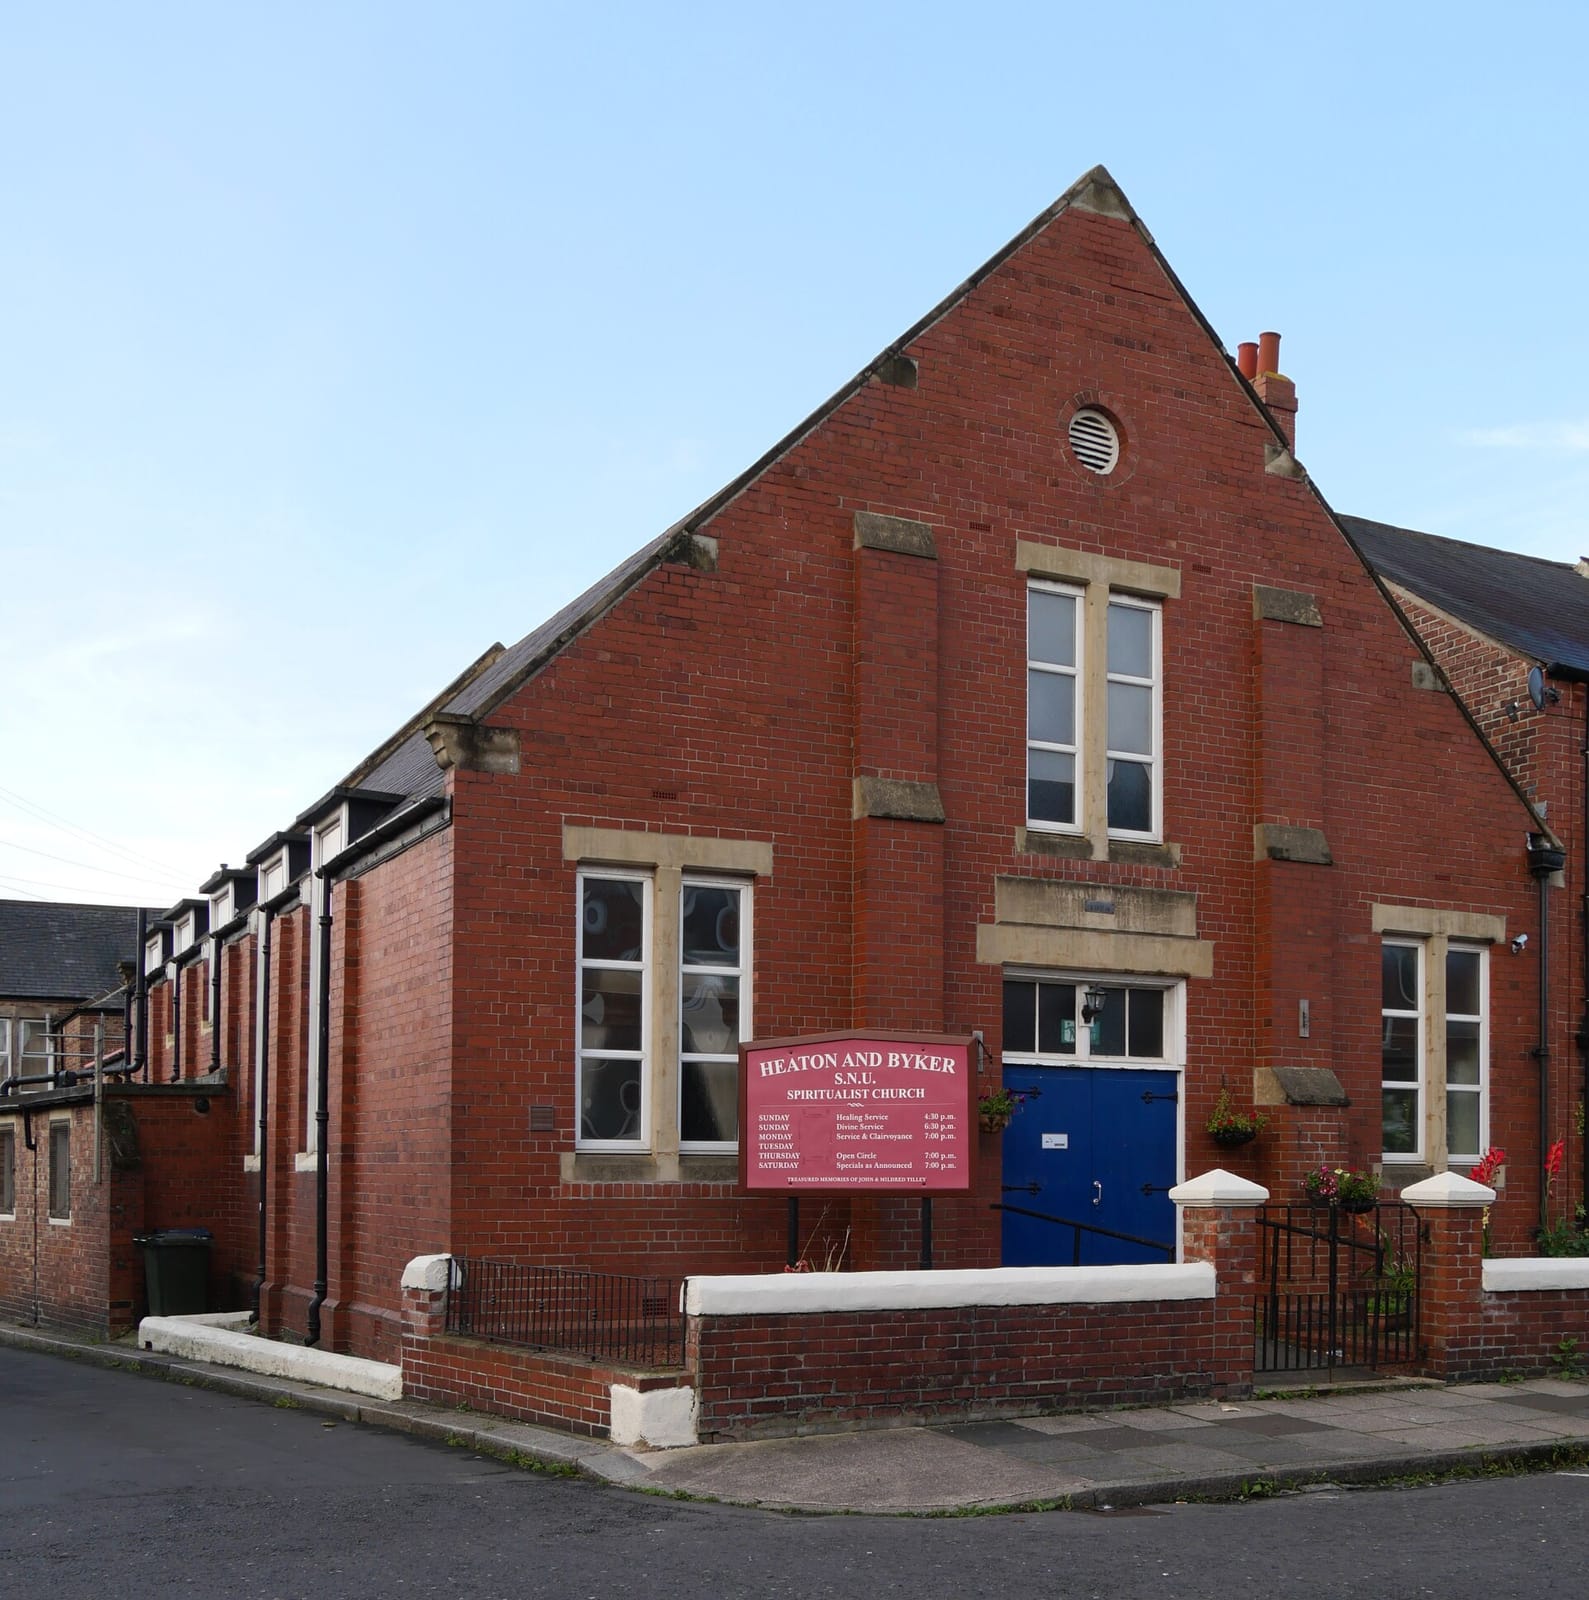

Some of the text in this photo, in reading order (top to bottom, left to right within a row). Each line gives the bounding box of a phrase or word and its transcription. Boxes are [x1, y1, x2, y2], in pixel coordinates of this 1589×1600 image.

[760, 1053, 956, 1077] HEATON AND BYKER
[835, 1073, 876, 1085] S.N.U.
[787, 1089, 925, 1099] SPIRITUALIST CHURCH
[837, 1114, 863, 1122] Healing
[870, 1133, 912, 1141] Clairvoyance
[837, 1152, 855, 1160] Open
[837, 1162, 863, 1170] Specials
